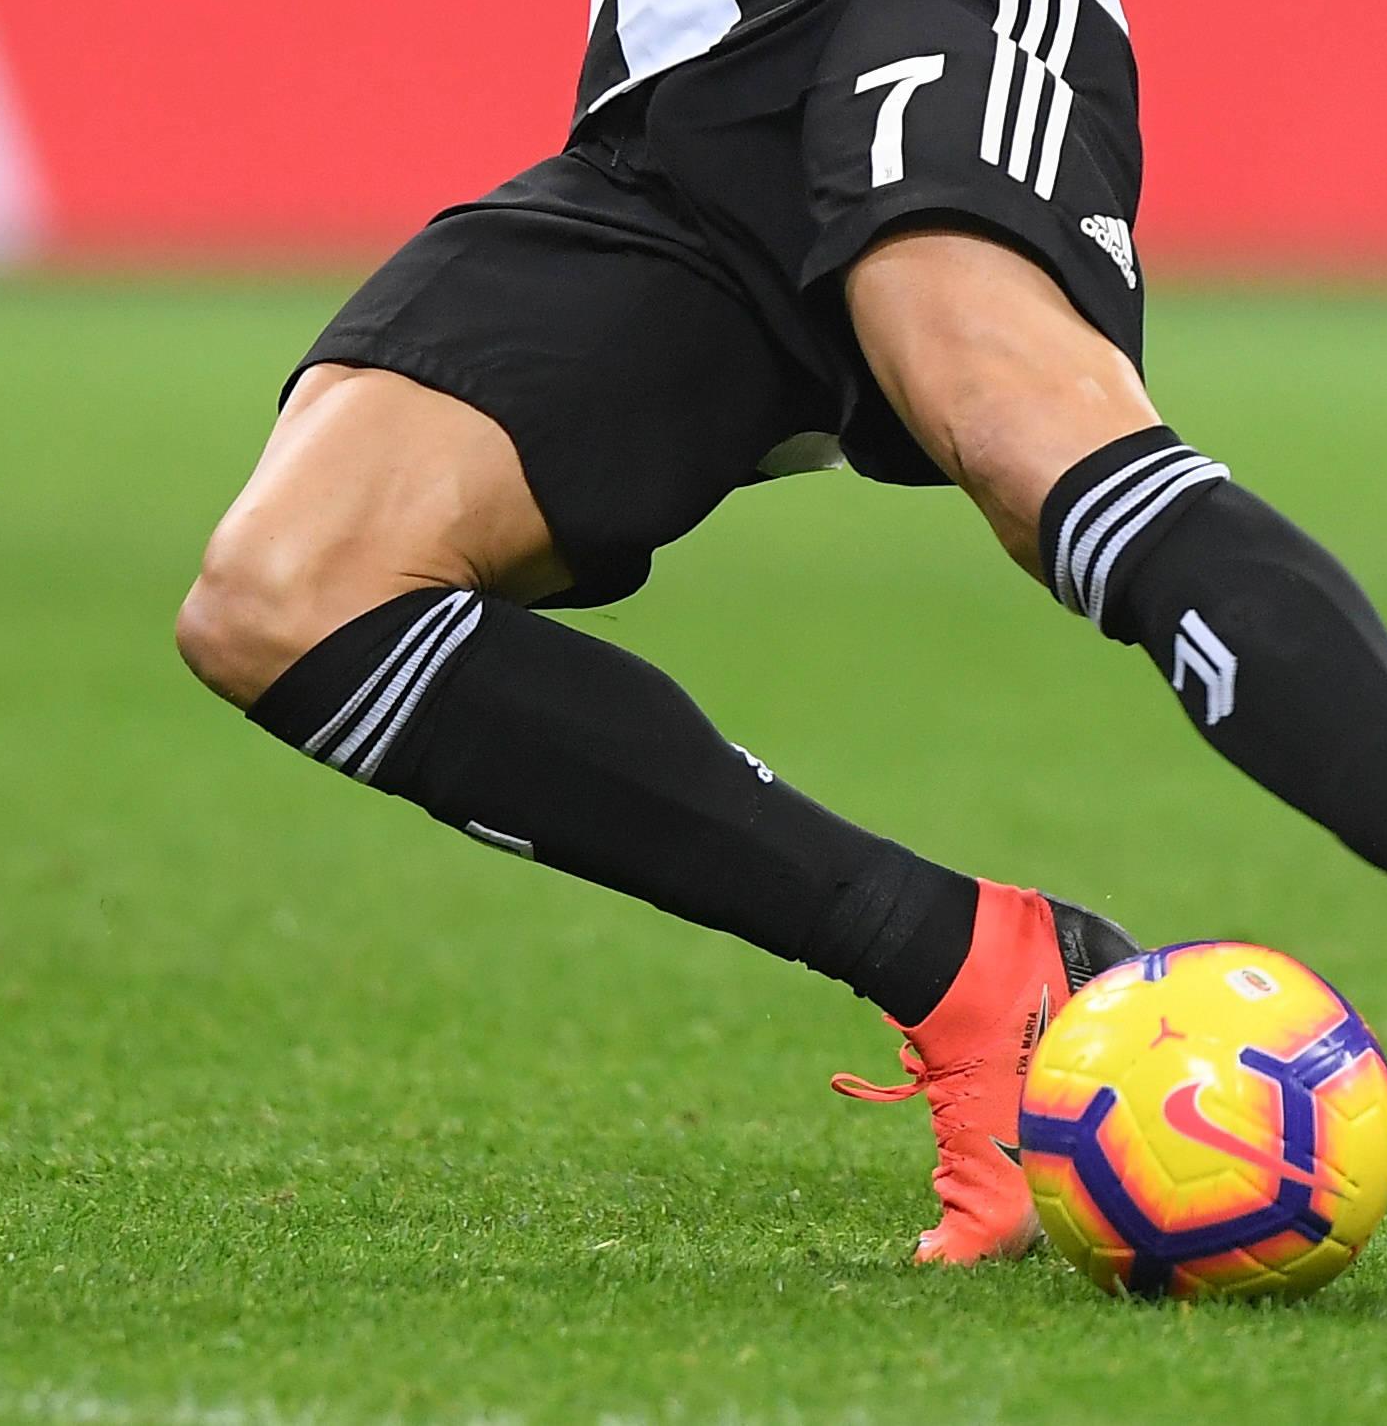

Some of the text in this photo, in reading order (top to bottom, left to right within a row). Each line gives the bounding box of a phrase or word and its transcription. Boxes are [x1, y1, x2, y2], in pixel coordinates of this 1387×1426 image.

[854, 53, 945, 188] 7
[1080, 217, 1137, 290] adidas
[1017, 1012, 1038, 1075] EVA MARIA
